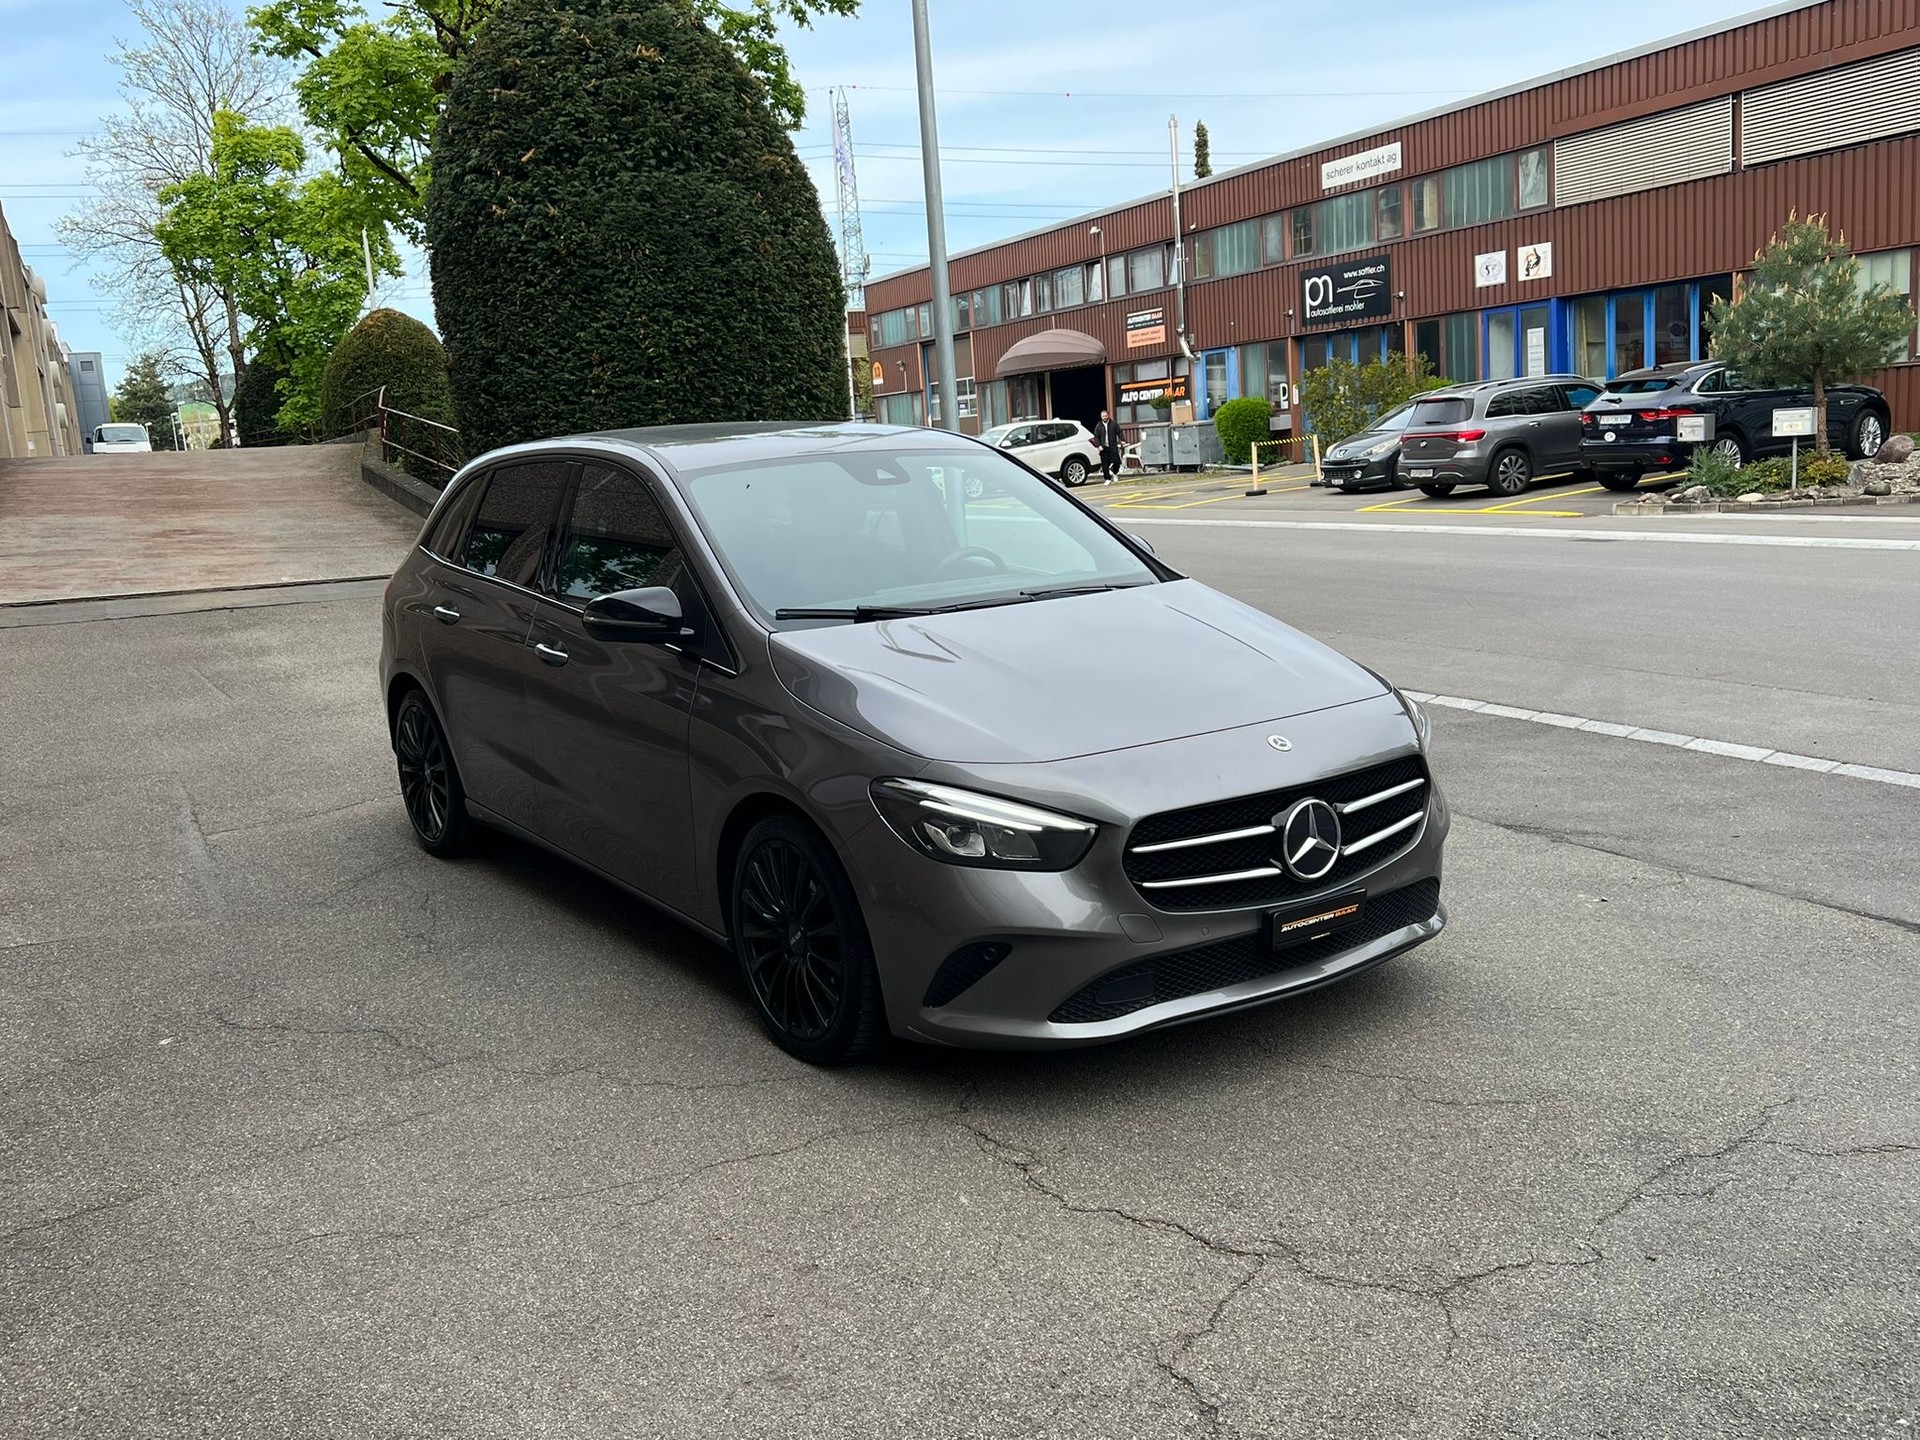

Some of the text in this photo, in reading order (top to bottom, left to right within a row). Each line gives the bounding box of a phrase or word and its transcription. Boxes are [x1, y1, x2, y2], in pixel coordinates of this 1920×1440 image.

[1326, 152, 1397, 180] scherer kontakt ag
[1344, 300, 1365, 312] mohler
[1281, 907, 1358, 933] AUTOCENTER BAAR
